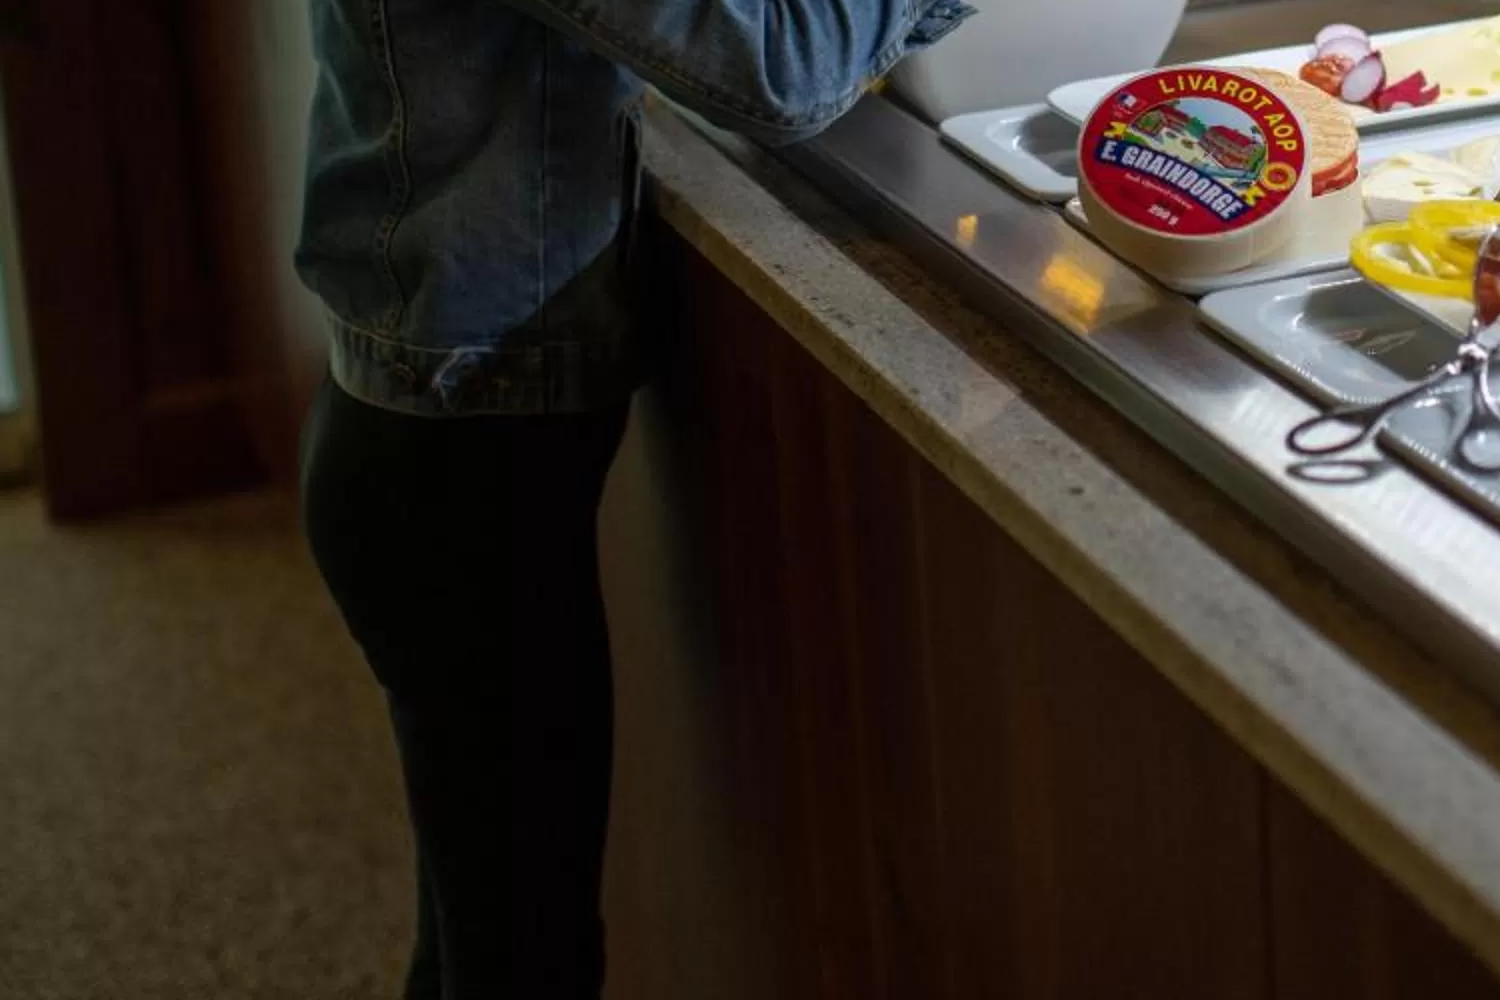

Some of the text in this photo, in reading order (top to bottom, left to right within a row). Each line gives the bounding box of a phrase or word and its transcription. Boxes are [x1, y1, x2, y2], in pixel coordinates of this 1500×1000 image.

[1158, 75, 1272, 111] LIVAROT
[1263, 113, 1297, 151] AOP
[1121, 145, 1244, 220] GRAINDORGE
